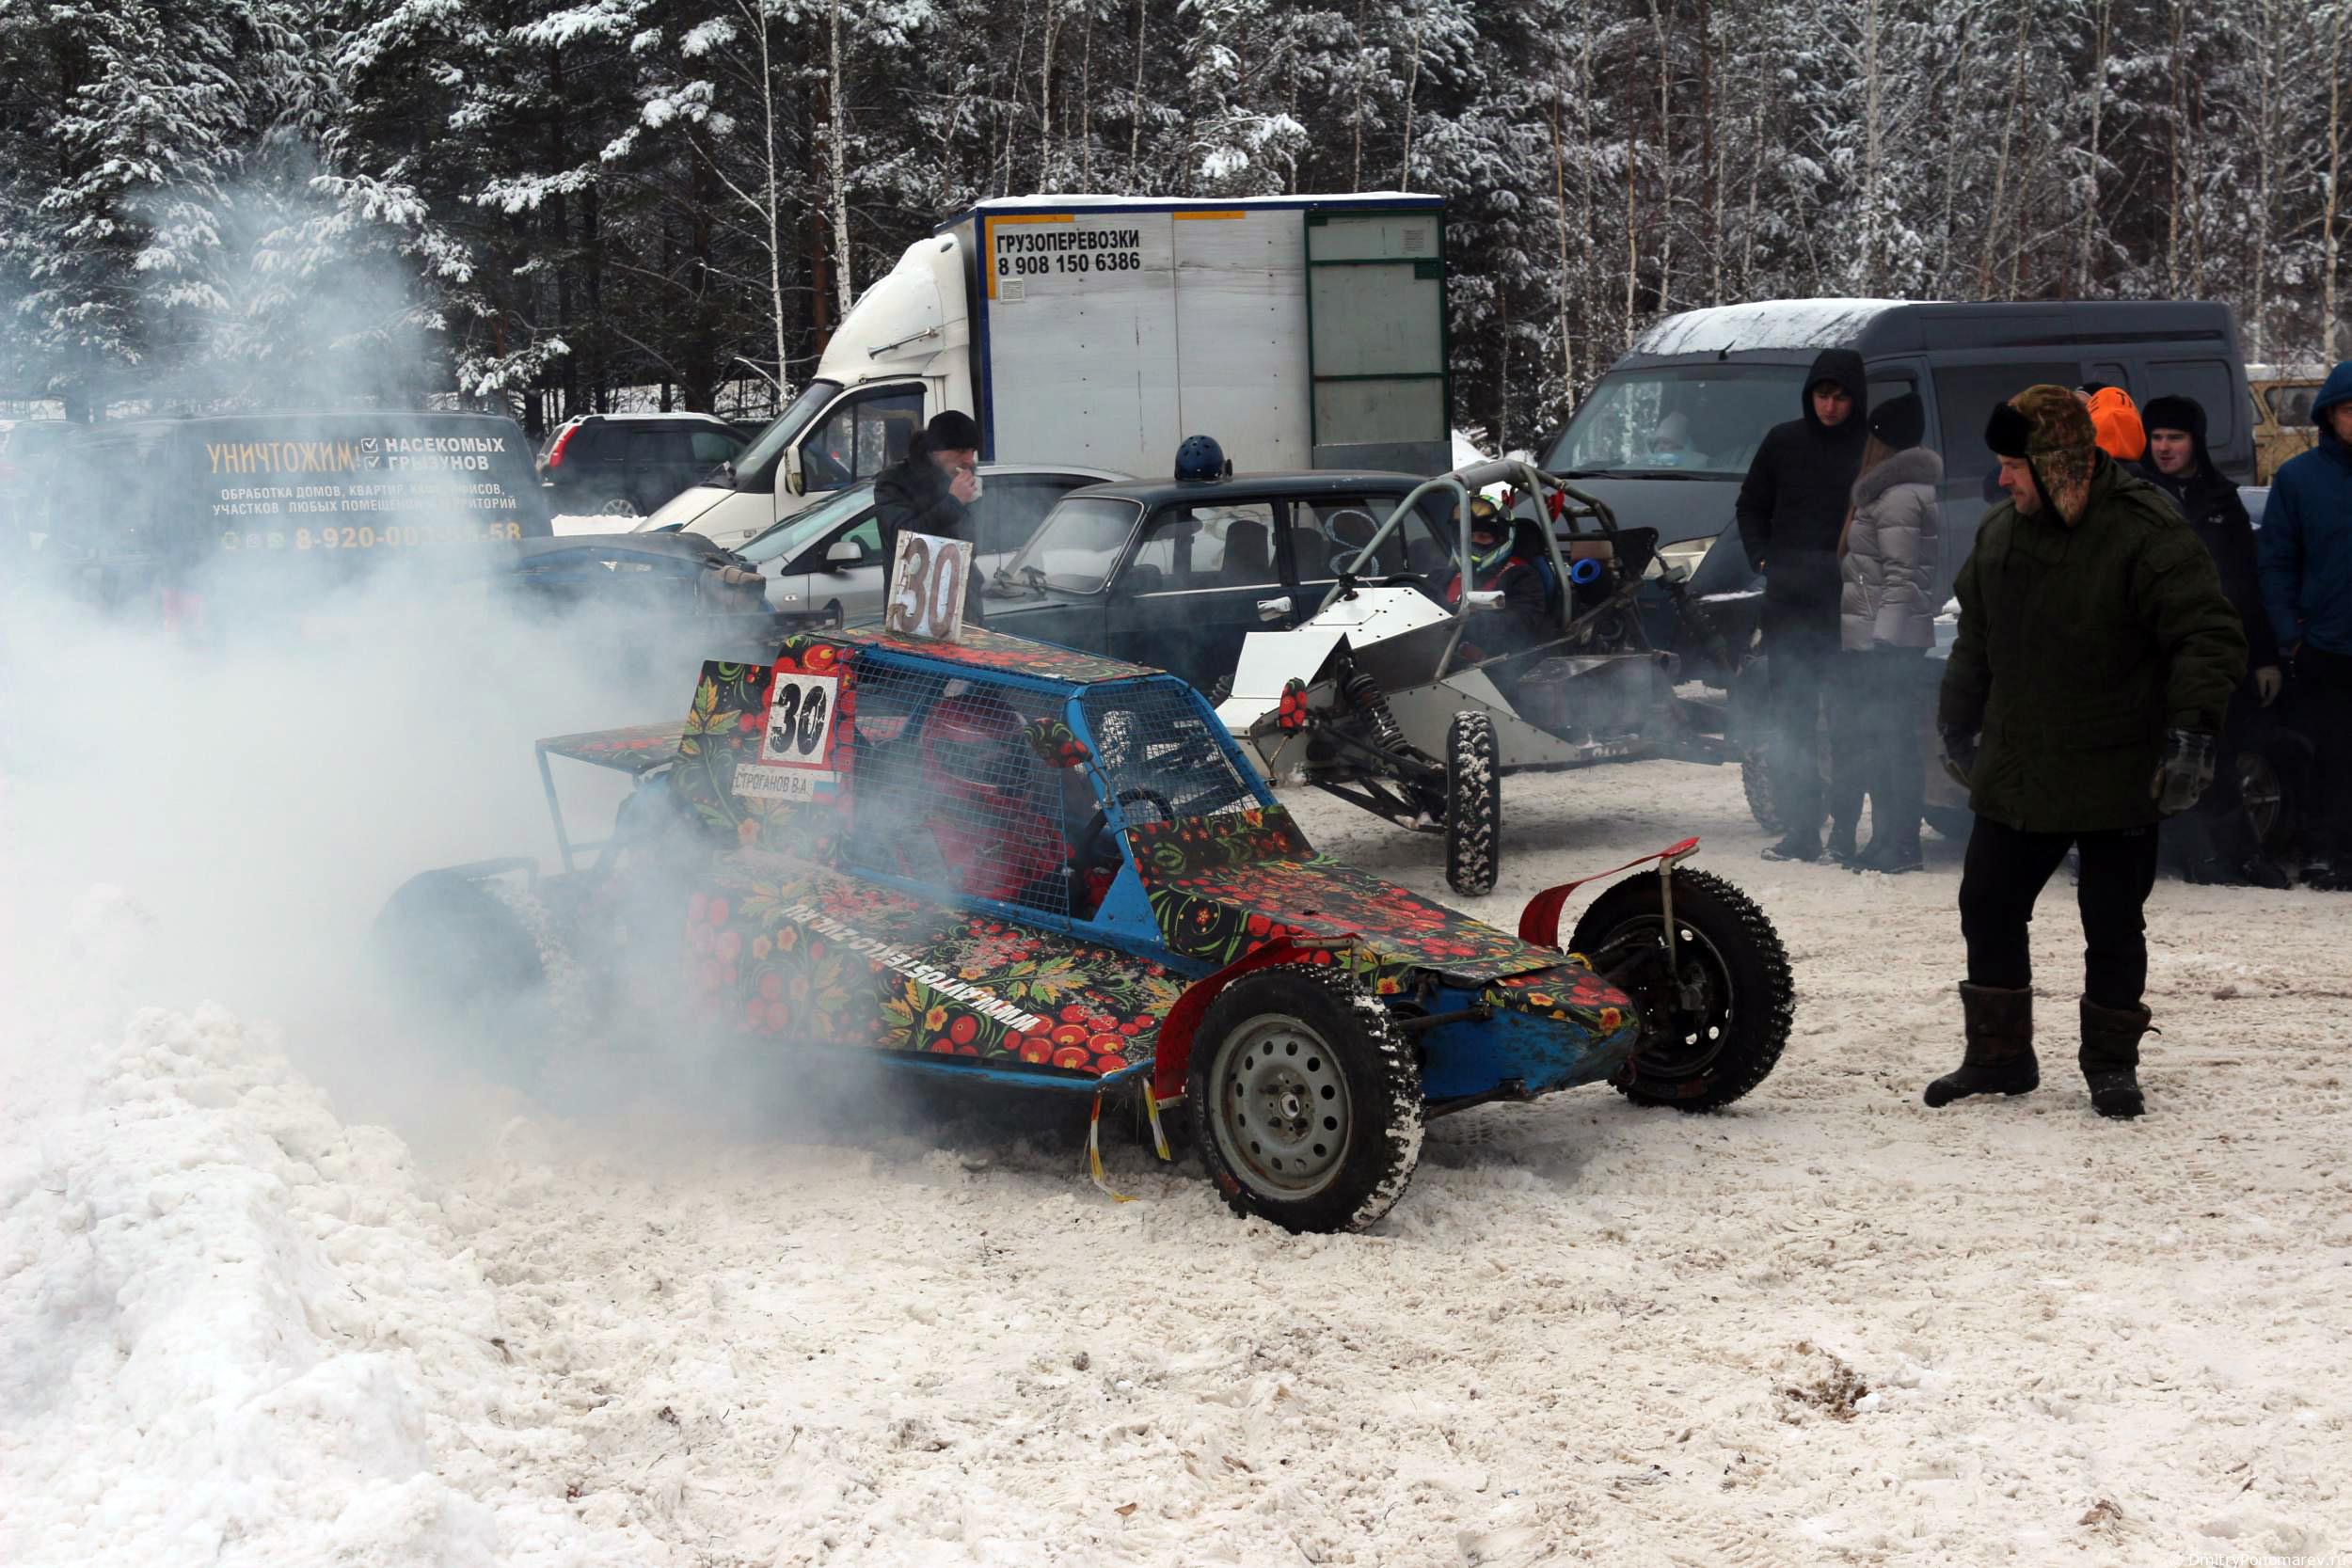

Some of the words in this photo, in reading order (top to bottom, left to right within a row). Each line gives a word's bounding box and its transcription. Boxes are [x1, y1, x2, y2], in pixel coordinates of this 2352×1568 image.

[997, 230, 1139, 253] ГРУЗОПЕРЕВОЗКИ
[998, 258, 1009, 276] 8
[1015, 256, 1049, 275] 908
[1057, 254, 1089, 273] 150
[1095, 251, 1140, 271] 6386
[385, 437, 505, 452] НАСЕКОМЫХ
[388, 455, 489, 470] ГРЫЗУНОВ
[221, 487, 293, 500] ОБРАБОТКА
[296, 485, 345, 499] ДОМОВ,
[213, 501, 278, 516] УЧАСТКОВ
[289, 500, 338, 513] ЛЮБЫХ
[896, 537, 961, 639] 30
[770, 683, 826, 755] 30
[736, 772, 790, 793] СТРОГАНОВ
